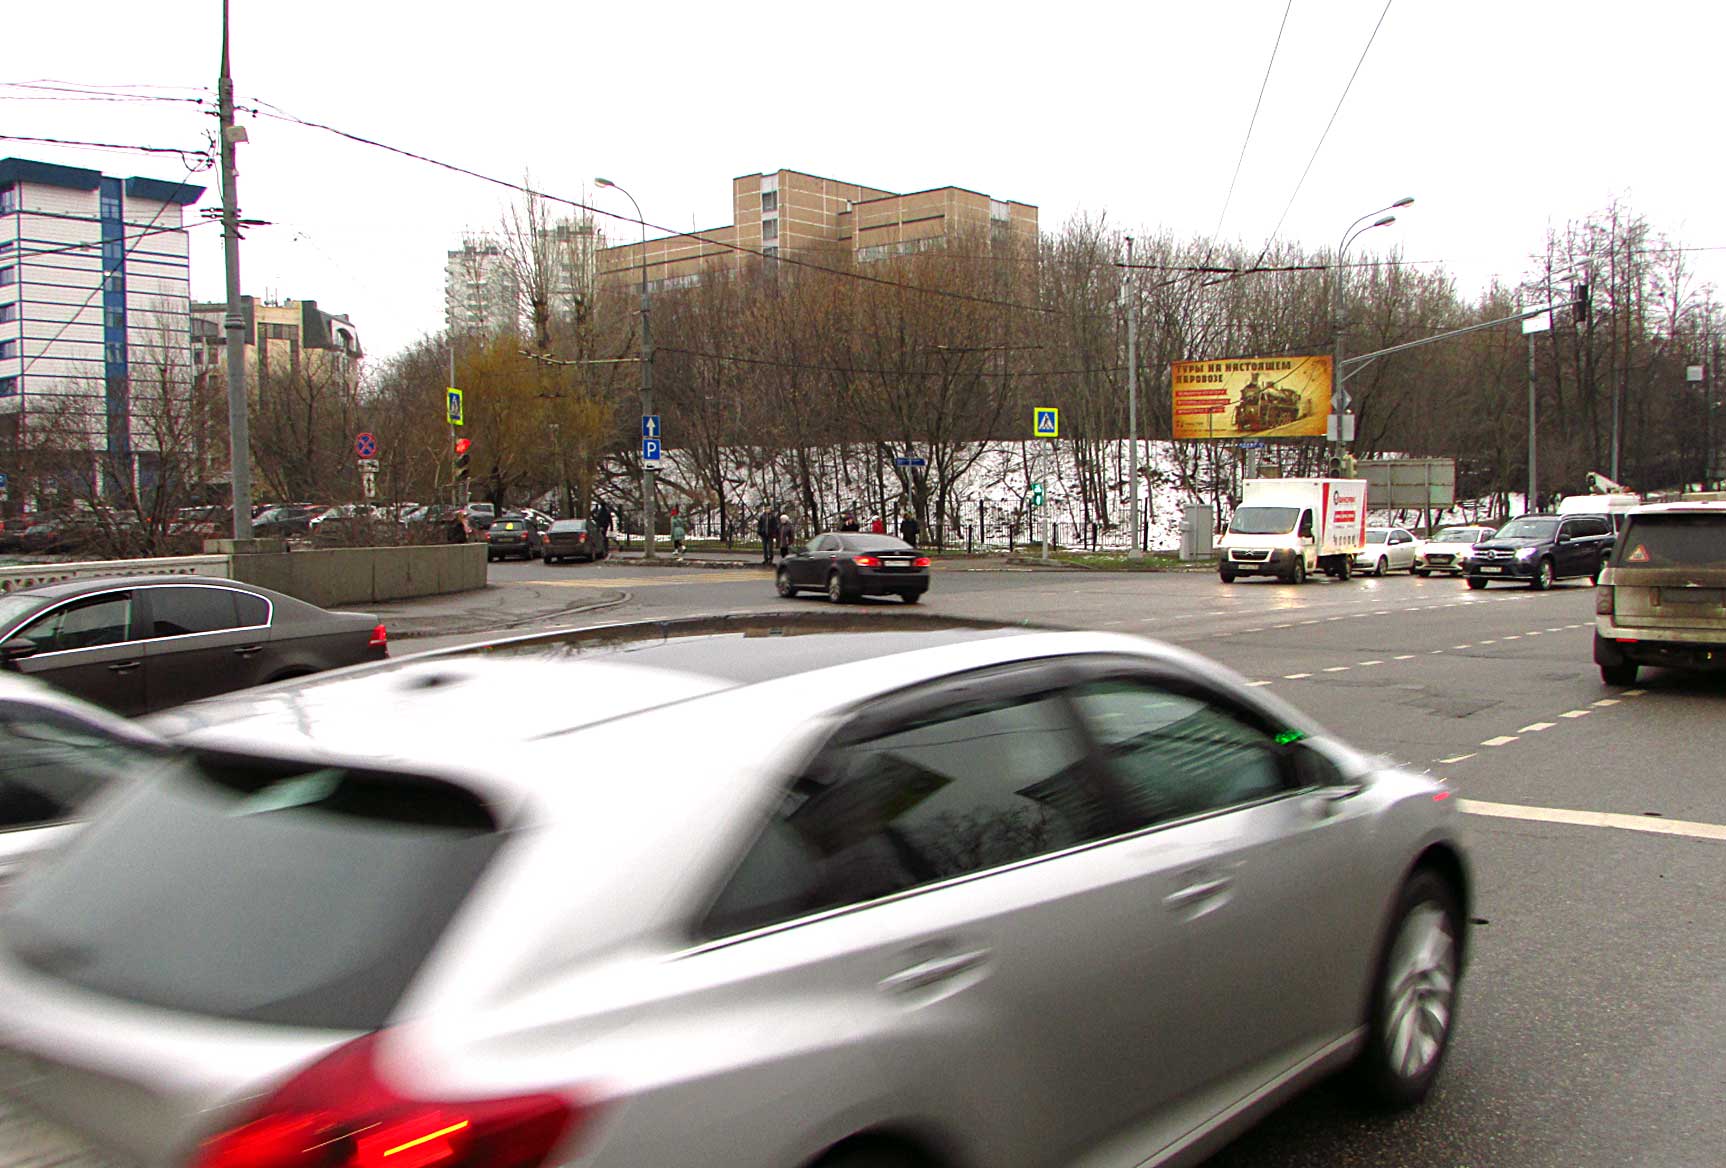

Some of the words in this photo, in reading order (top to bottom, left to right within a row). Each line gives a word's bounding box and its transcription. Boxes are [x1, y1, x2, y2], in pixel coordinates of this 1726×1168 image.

[1176, 364, 1204, 374] ТУРЫ
[1208, 363, 1222, 373] НА
[1225, 361, 1291, 373] НАСТОЯЩЕМ
[1176, 374, 1223, 384] ПАРОВОЗЕ
[647, 441, 657, 458] P
